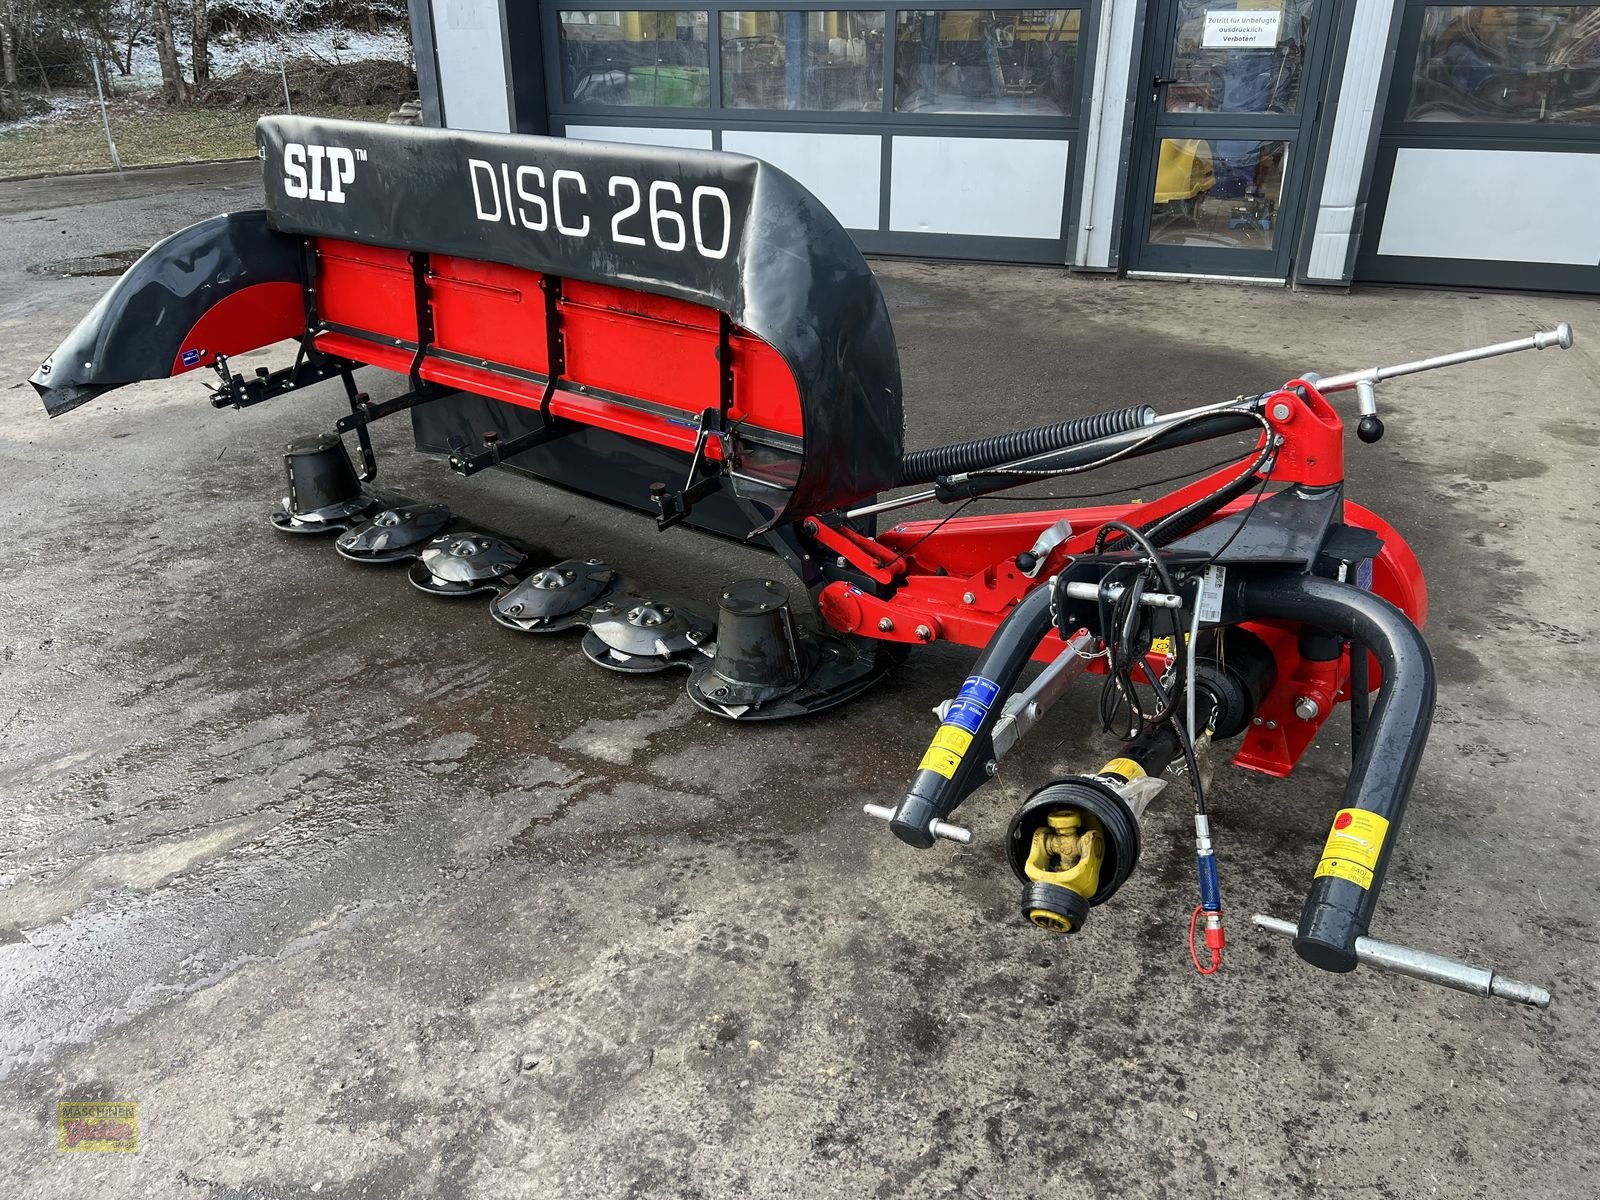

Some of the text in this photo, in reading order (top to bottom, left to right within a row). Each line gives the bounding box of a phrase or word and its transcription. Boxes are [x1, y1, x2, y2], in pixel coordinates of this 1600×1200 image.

[1241, 17, 1277, 25] Unbefugte
[284, 143, 355, 203] SIP
[468, 158, 731, 260] DISC 260
